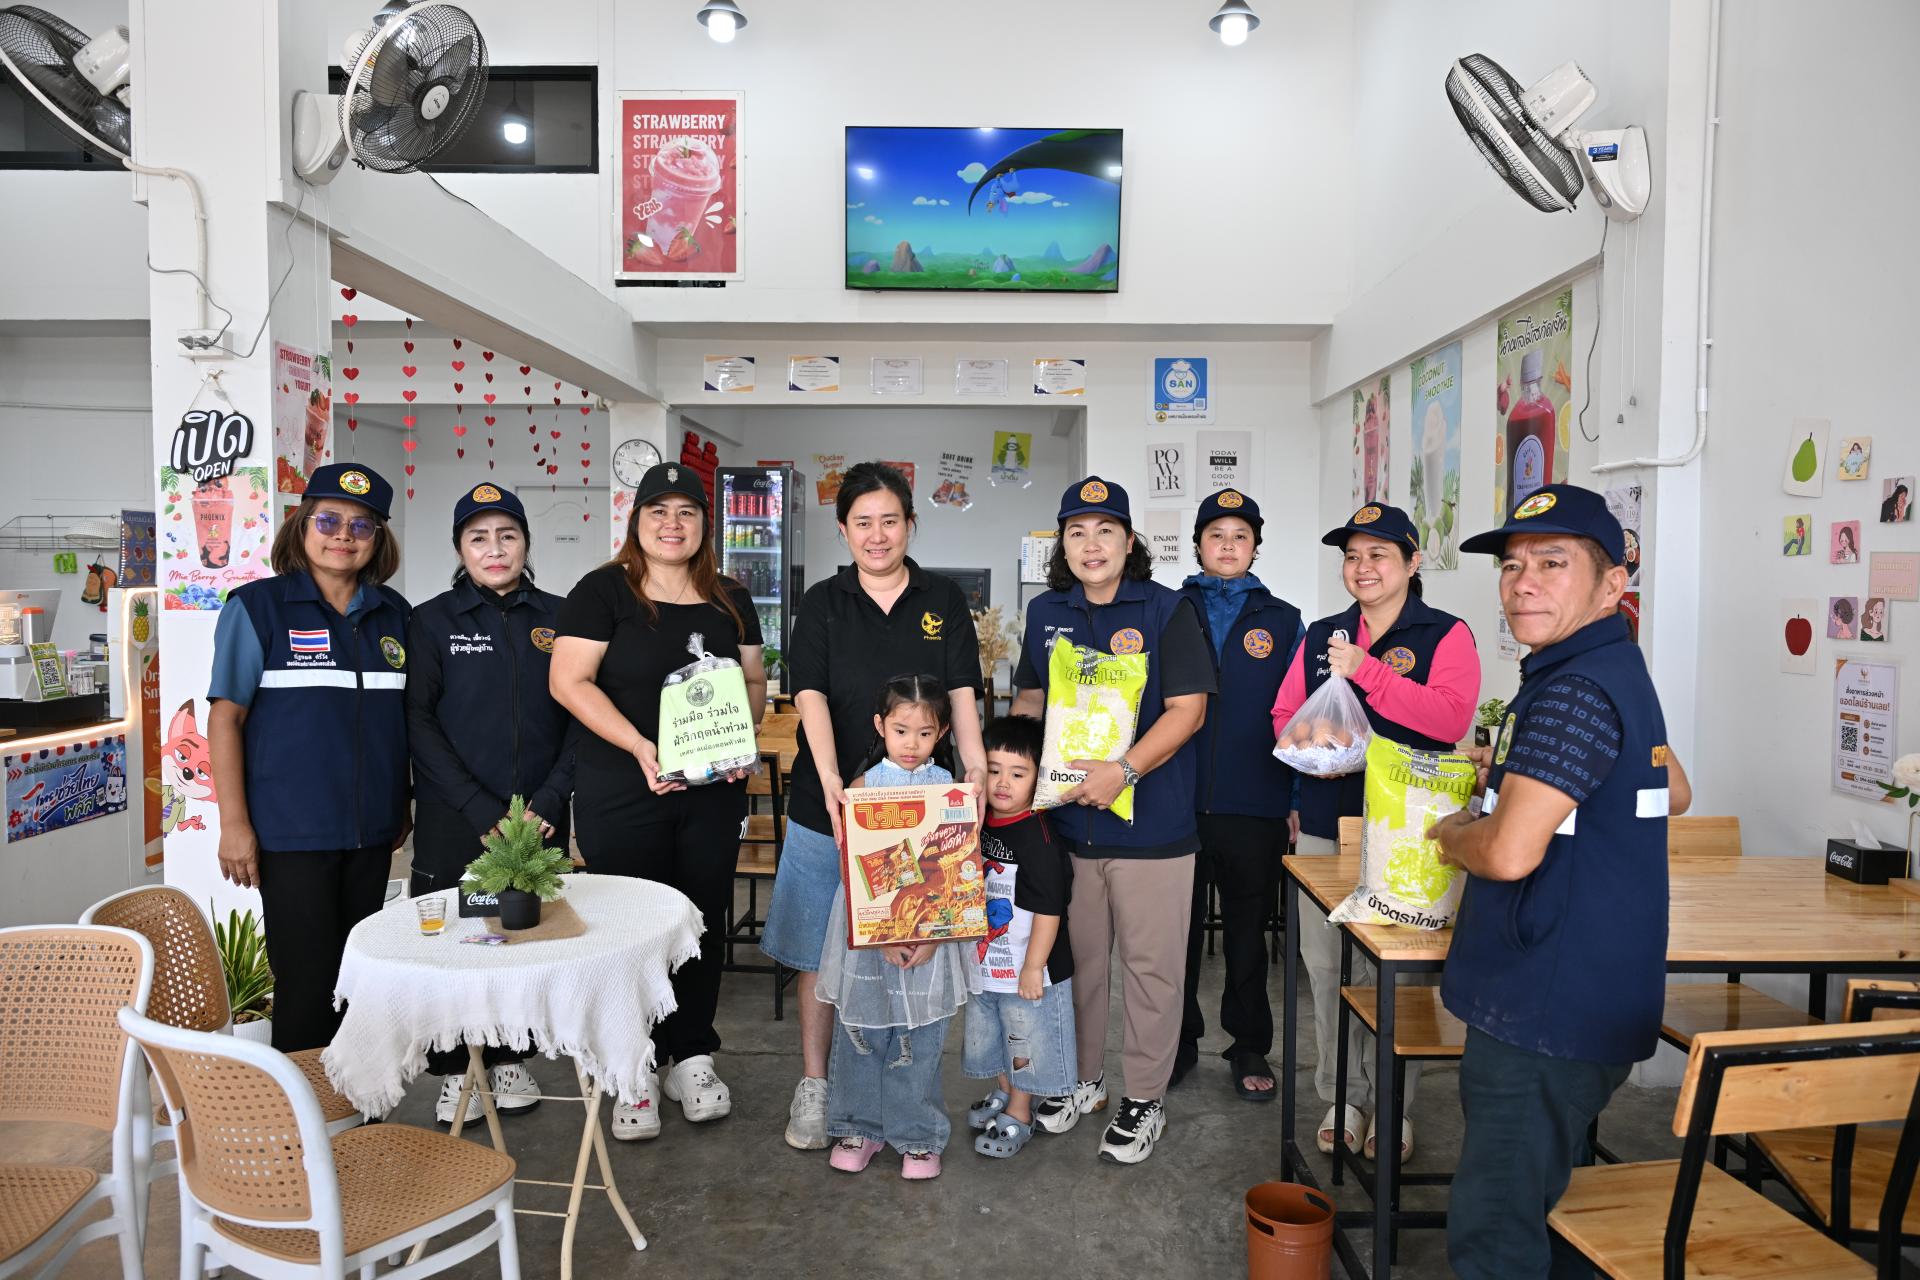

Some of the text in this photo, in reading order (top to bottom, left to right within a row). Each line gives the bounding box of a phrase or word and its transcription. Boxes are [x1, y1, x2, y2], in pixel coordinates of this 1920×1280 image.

[633, 114, 725, 129] STRAWBERRY
[635, 200, 661, 218] YEAH
[280, 348, 311, 367] STRAWBERRY
[1418, 361, 1445, 387] COCONUT
[1169, 380, 1193, 388] SAN
[1424, 375, 1454, 401] SMOOTHIE
[173, 412, 249, 470] เปิด
[957, 455, 973, 463] DRINK
[1154, 448, 1179, 465] PO
[194, 460, 231, 482] OPEN
[1156, 475, 1181, 491] ER
[200, 513, 225, 521] PHOENIX
[1153, 535, 1179, 543] ENJOY
[188, 570, 217, 585] Berry
[450, 643, 494, 655] ผู้ช่วยผู้ใหญ่บ้าน
[672, 702, 739, 728] ร่วมมือ ร่วมใจ
[1572, 705, 1587, 719] to
[674, 722, 748, 747] ฝ่าวิกฤตน้ำท่วม
[1566, 724, 1594, 743] and
[1595, 740, 1618, 758] one
[1528, 731, 1588, 760] miss you
[1050, 769, 1088, 783] ข้าวตร
[1562, 760, 1590, 780] kiss
[1830, 851, 1853, 869] Coca-Cola
[987, 881, 1012, 896] MARVEL
[1368, 894, 1450, 929] ข้าวตราไก่แจ้
[989, 957, 1014, 967] MARVEL
[991, 969, 1017, 979] MARVEL
